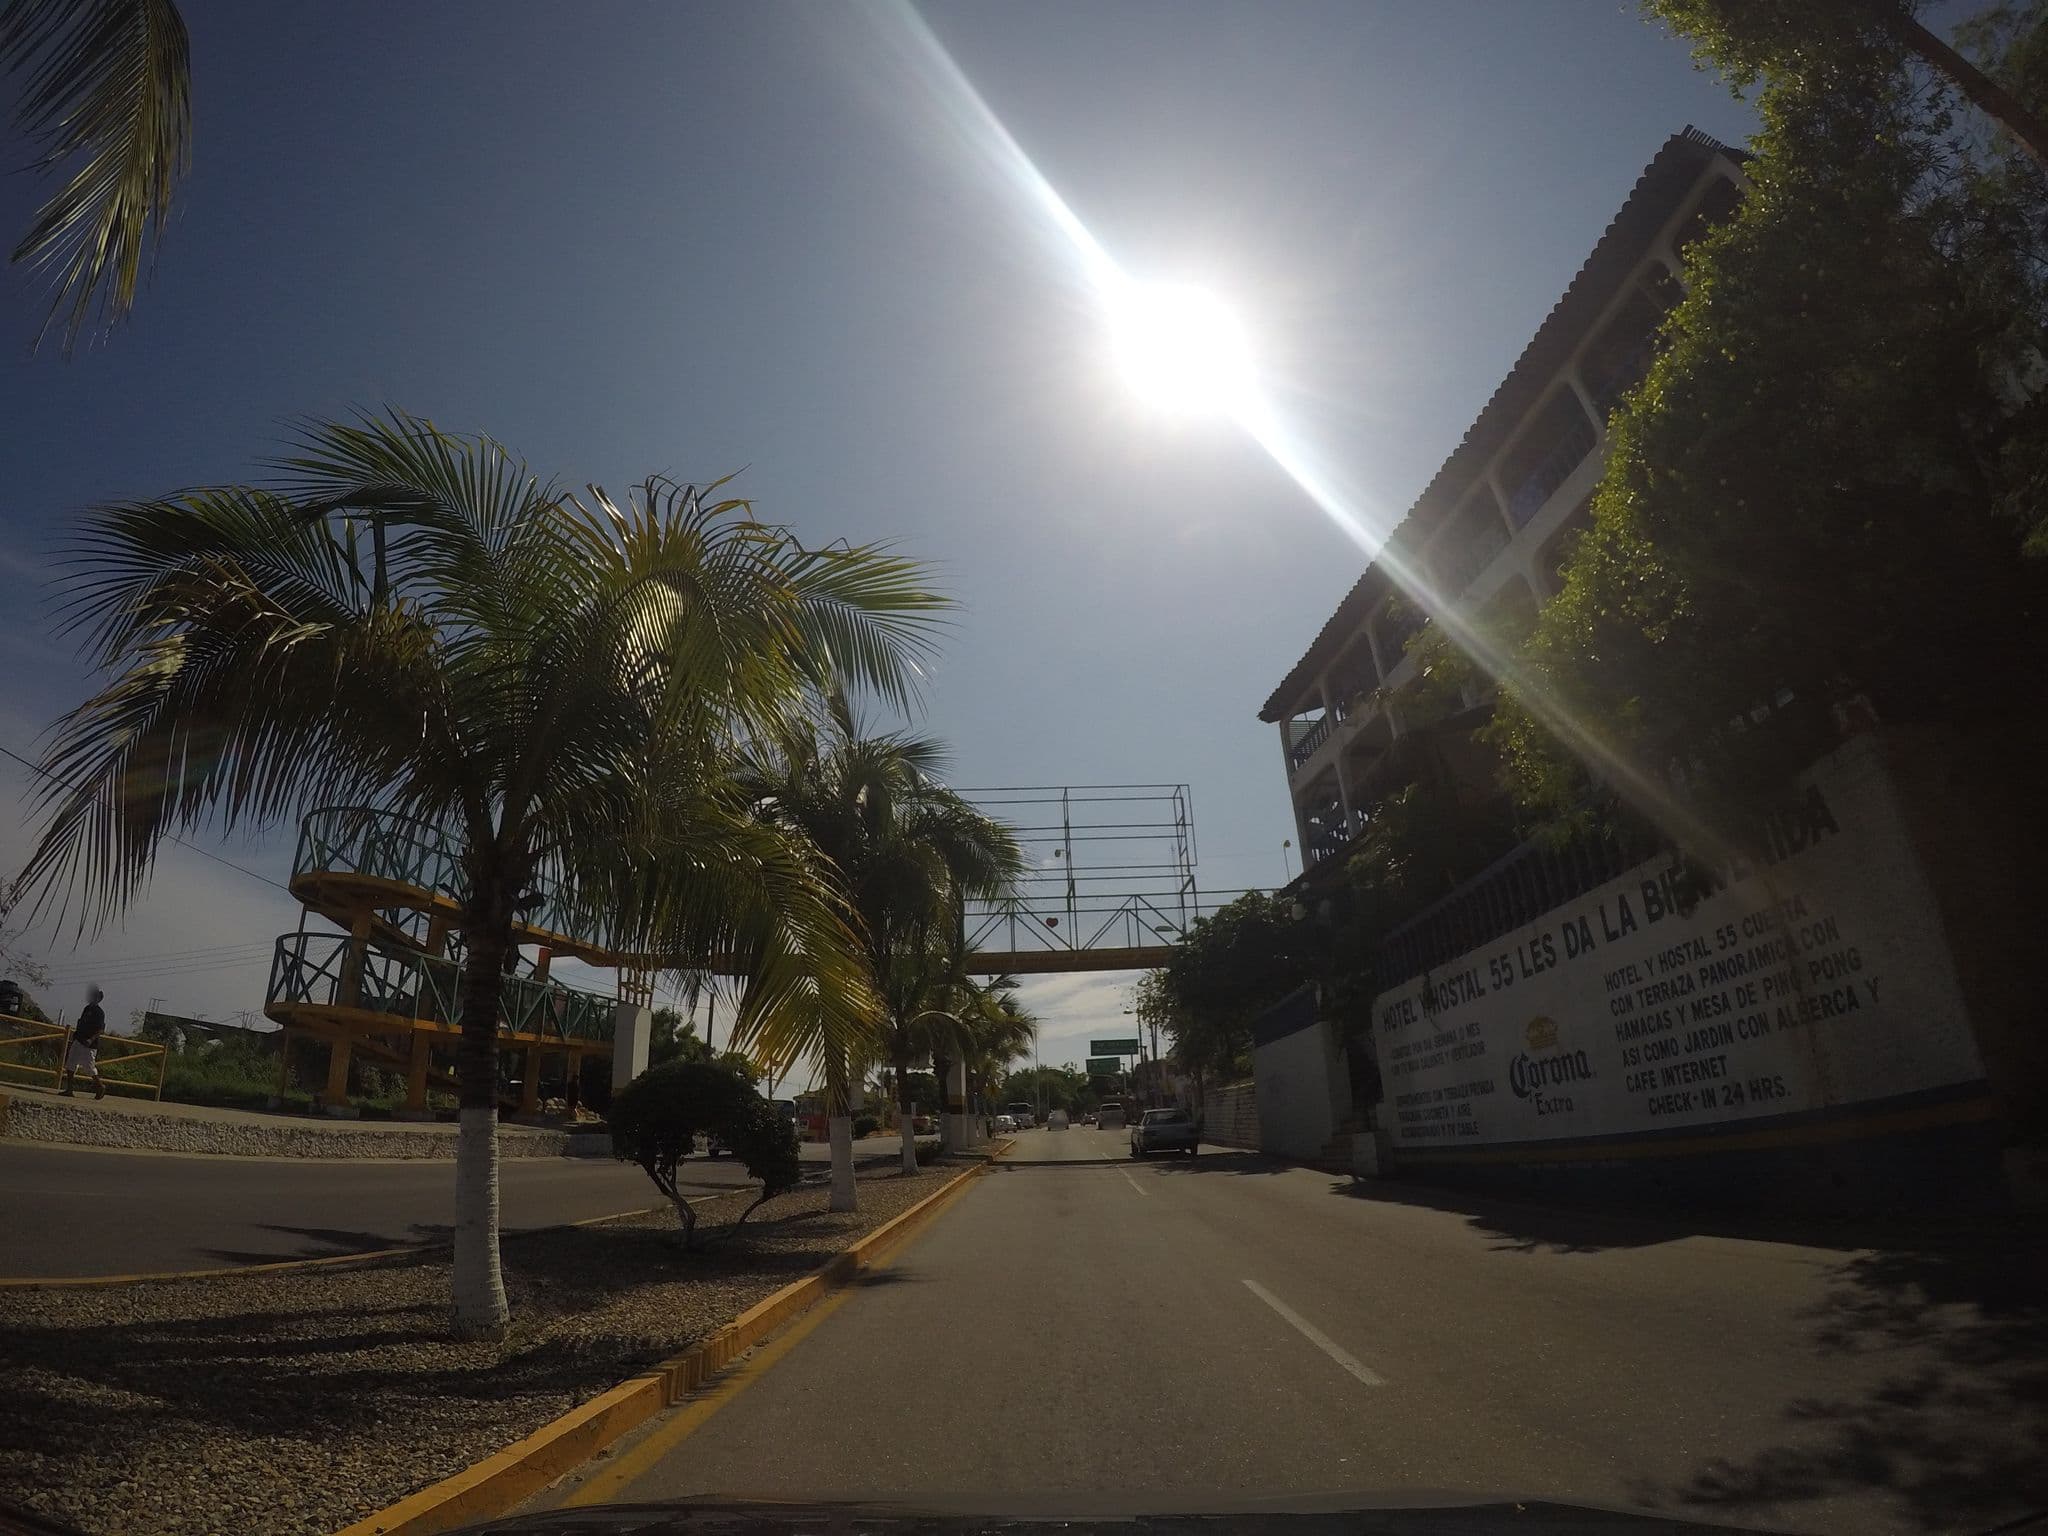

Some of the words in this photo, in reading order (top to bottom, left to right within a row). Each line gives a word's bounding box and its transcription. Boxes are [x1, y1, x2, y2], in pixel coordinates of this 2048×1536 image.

[1383, 998, 1417, 1032] HOTEL
[1430, 968, 1486, 1015] HOSTAL
[1489, 953, 1513, 990] 55
[1518, 932, 1557, 978] LES
[1562, 915, 1596, 960] DA
[1599, 893, 1638, 943] LA
[1603, 963, 1643, 993] HOTEL
[1644, 956, 1654, 977] Y
[1657, 936, 1712, 974] HOSTAL
[1715, 923, 1738, 951] 55
[1742, 893, 1808, 939] CUETA
[1610, 993, 1634, 1016] CON
[1636, 972, 1696, 1008] TERRAZA
[1801, 915, 1840, 951] CON
[1615, 1010, 1672, 1042] HAMACAS
[1676, 1004, 1686, 1026] Y
[1691, 992, 1732, 1021] MESA
[1736, 982, 1758, 1008] DE
[1808, 947, 1862, 984] PONG
[1623, 1046, 1641, 1068] ASI
[1644, 1037, 1679, 1062] COMO
[1684, 1021, 1734, 1053] JARDIN
[1737, 1011, 1770, 1040] CON
[1777, 985, 1860, 1031] ALBERCA
[1863, 975, 1880, 1003] Y
[1509, 1049, 1592, 1098] Corona
[1535, 1091, 1574, 1115] Extra
[1626, 1069, 1658, 1093] CAFE
[1660, 1054, 1727, 1088] INTERNET
[1721, 1081, 1745, 1106] 24
[1748, 1074, 1792, 1101] HRS.
